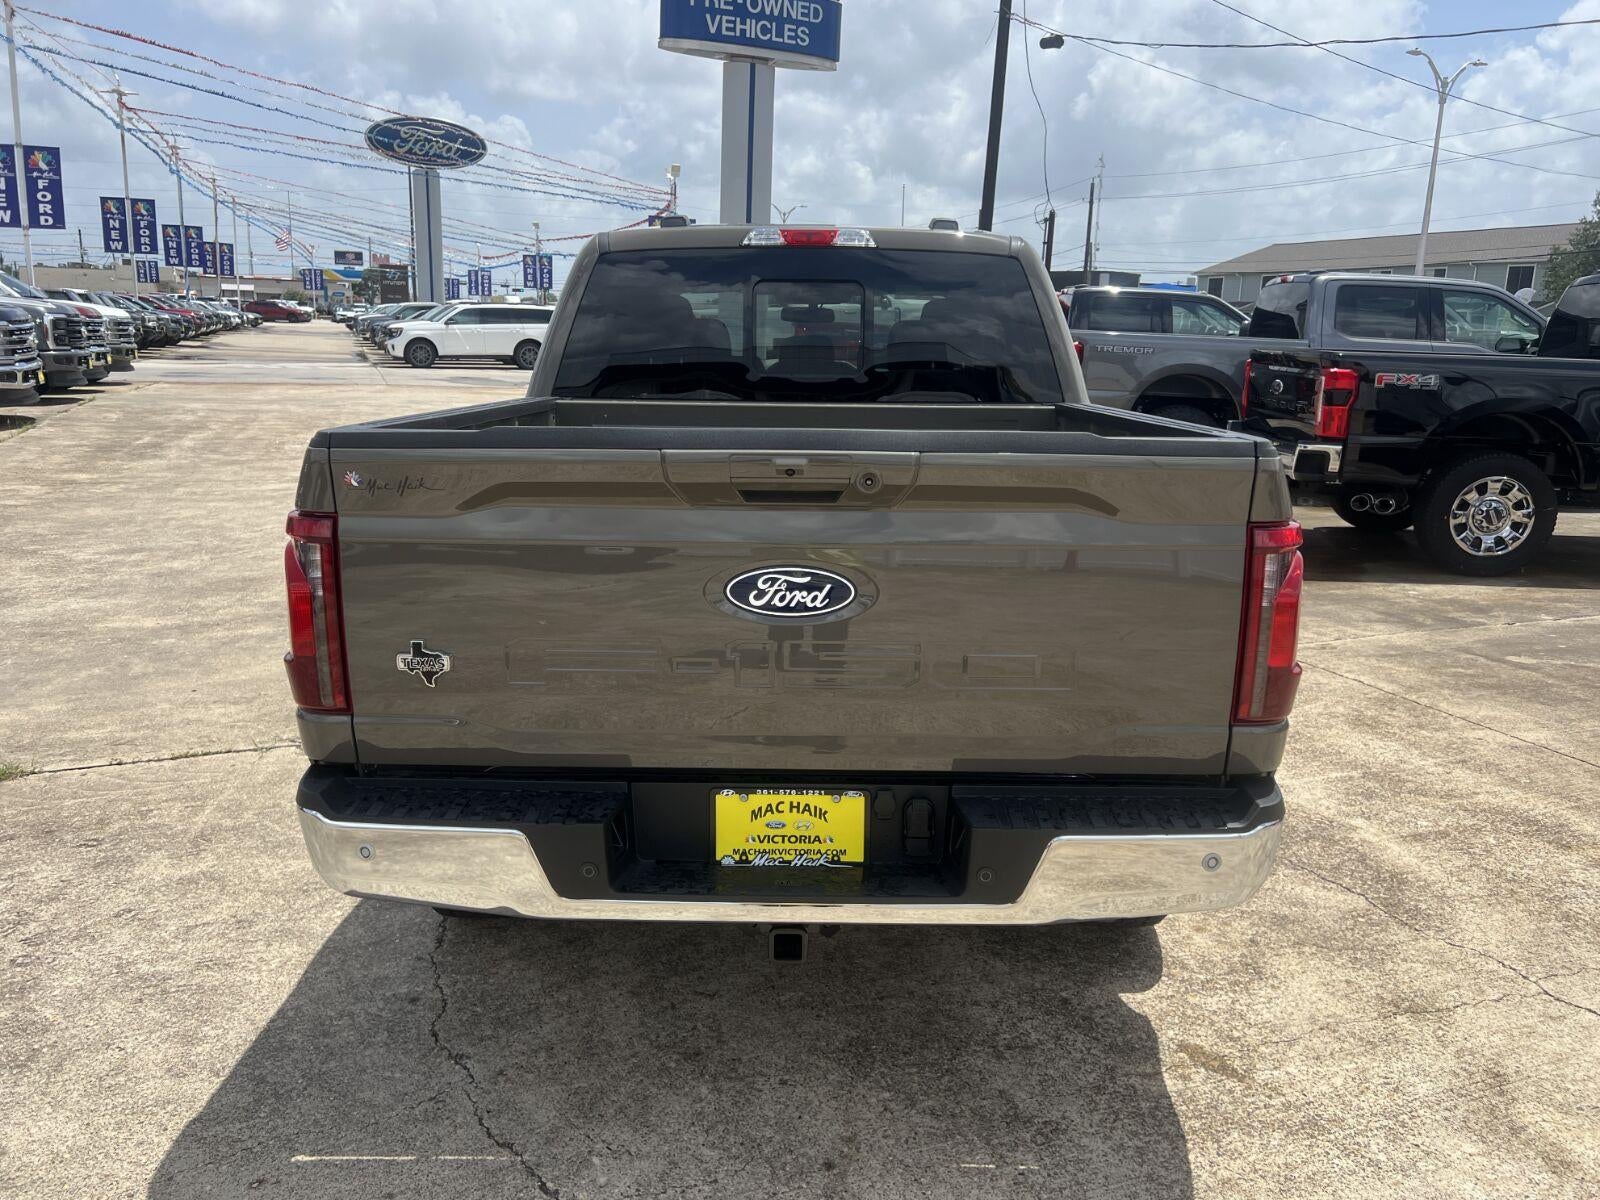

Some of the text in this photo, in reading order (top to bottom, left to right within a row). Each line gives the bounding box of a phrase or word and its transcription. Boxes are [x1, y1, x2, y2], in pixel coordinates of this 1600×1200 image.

[705, 14, 810, 46] VEHICLES
[394, 126, 462, 158] Ford
[37, 179, 54, 225] FORD
[109, 219, 122, 250] NEW
[139, 221, 151, 252] FORD
[169, 241, 179, 265] NEW
[191, 242, 200, 266] FORD
[206, 253, 215, 274] NEW
[223, 256, 231, 275] FORD
[526, 267, 534, 287] NEW
[1096, 344, 1154, 354] TREMOR
[1375, 373, 1440, 389] FX4
[366, 476, 432, 497] Mac Haik
[748, 574, 832, 607] Ford
[401, 657, 446, 668] TEXAS
[750, 801, 829, 823] MAC HAIK
[757, 834, 823, 845] VICTORIA
[749, 853, 830, 867] Mac Haik
